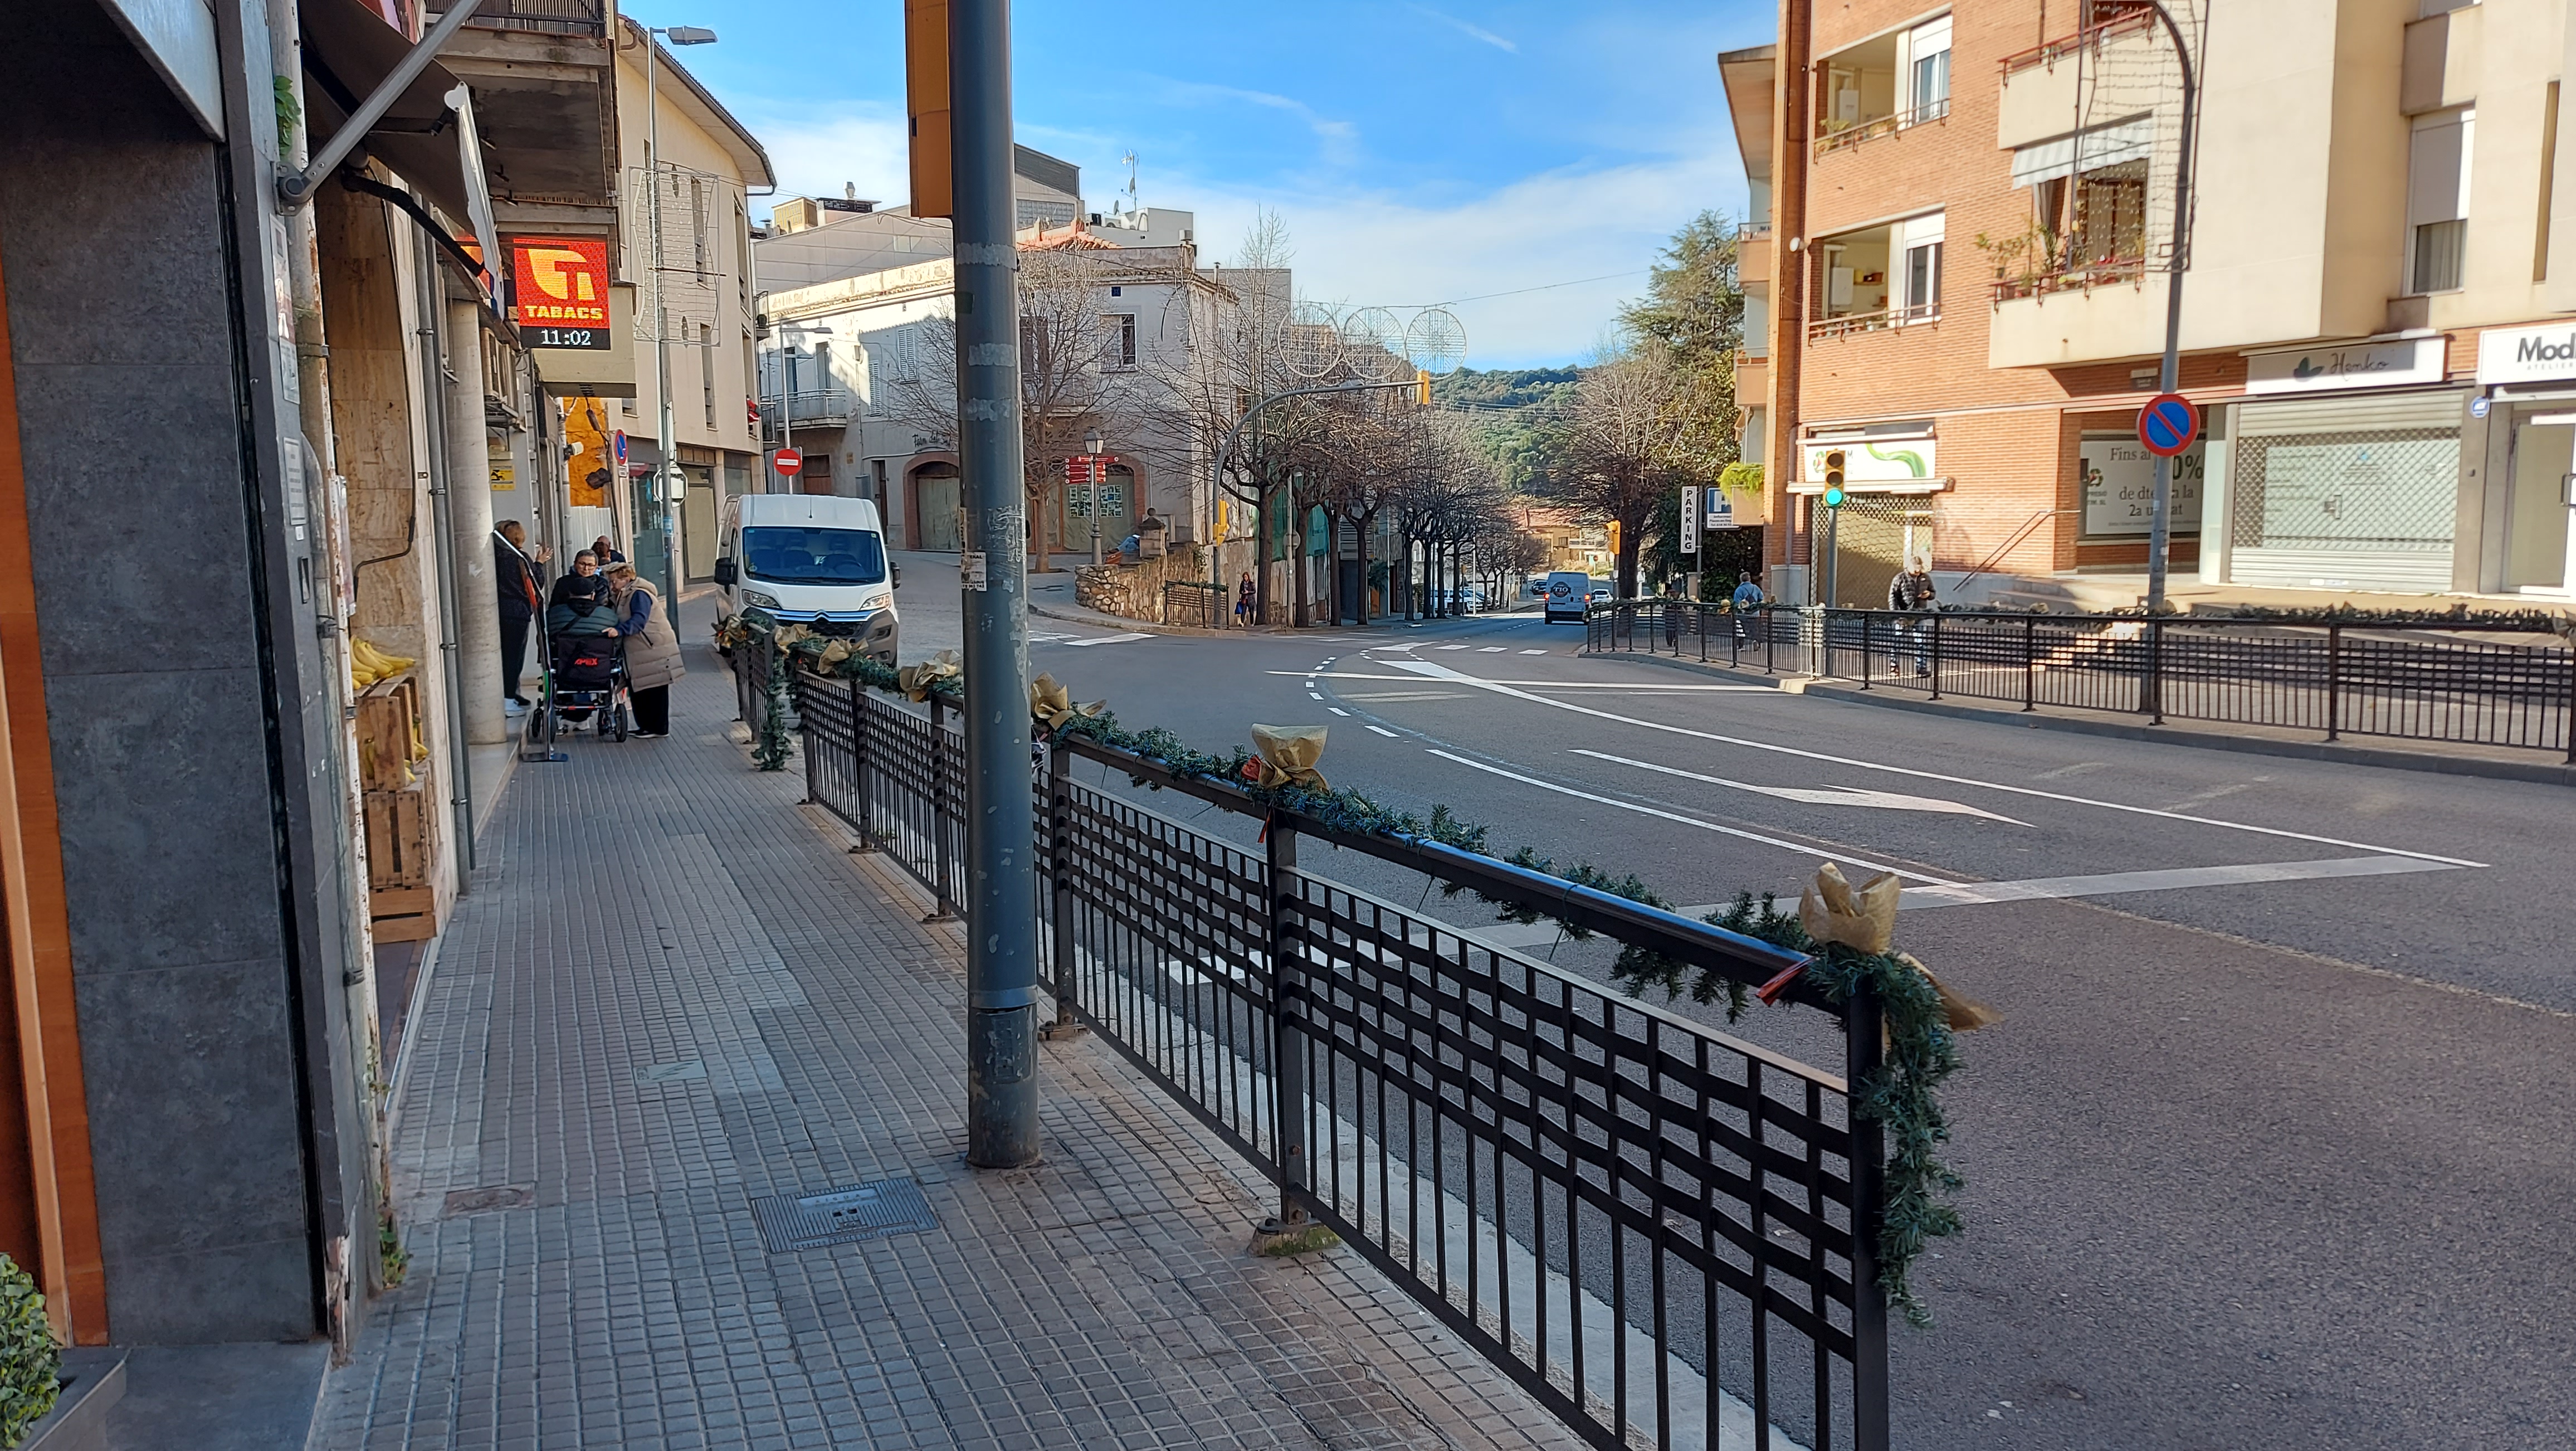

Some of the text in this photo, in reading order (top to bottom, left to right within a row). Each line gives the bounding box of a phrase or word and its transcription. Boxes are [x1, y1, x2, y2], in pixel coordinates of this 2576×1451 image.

[524, 305, 603, 319] TABACS
[541, 328, 592, 346] 11:02
[2517, 332, 2576, 363] Mod
[2329, 352, 2389, 382] Henko
[2109, 447, 2138, 461] Fins
[2119, 486, 2135, 500] de
[2182, 485, 2194, 499] la
[2128, 504, 2142, 517] 2a
[1685, 490, 1693, 550] PARKING
